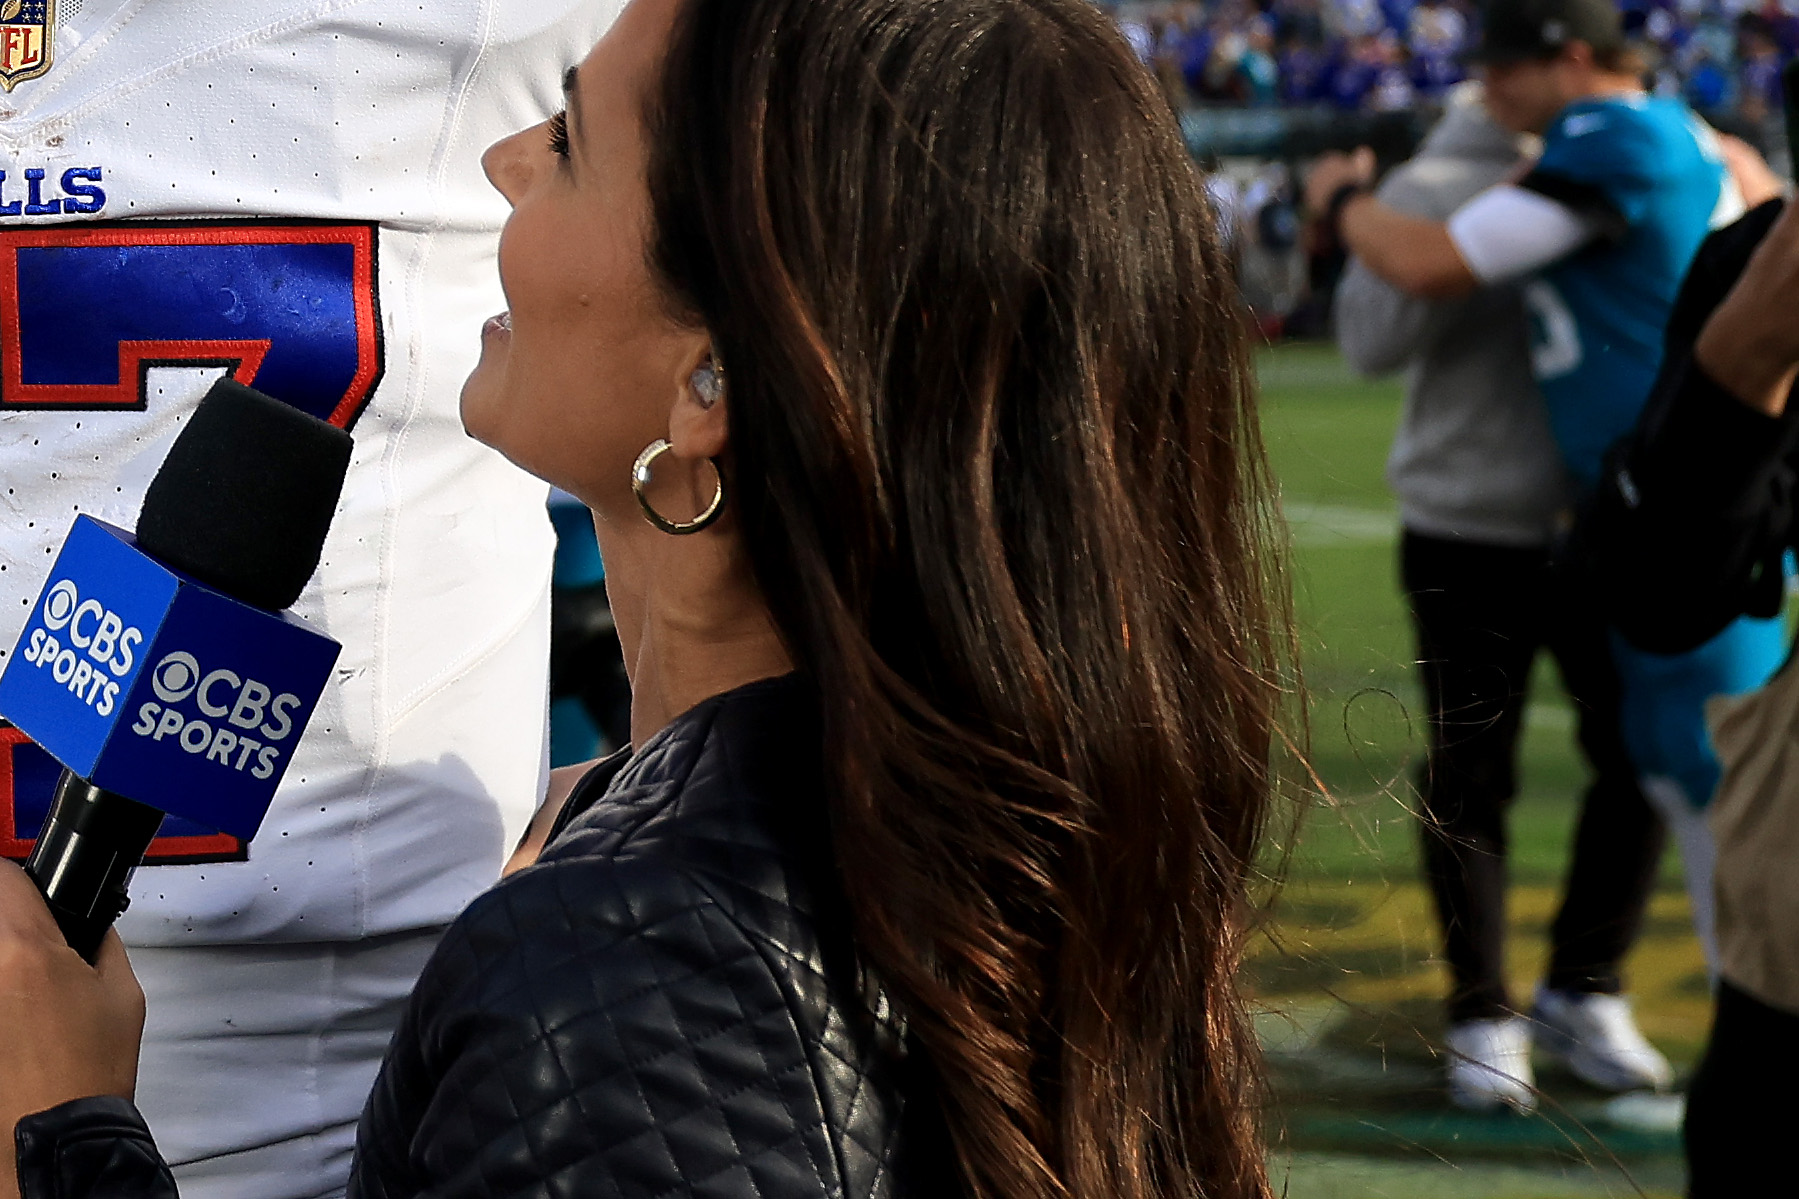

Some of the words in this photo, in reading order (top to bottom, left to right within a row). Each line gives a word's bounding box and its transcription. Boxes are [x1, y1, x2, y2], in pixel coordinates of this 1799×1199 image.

[23, 627, 120, 717] SPORTS
[69, 598, 143, 677] CBS
[131, 701, 280, 780] SPORTS
[196, 668, 302, 741] CBS
